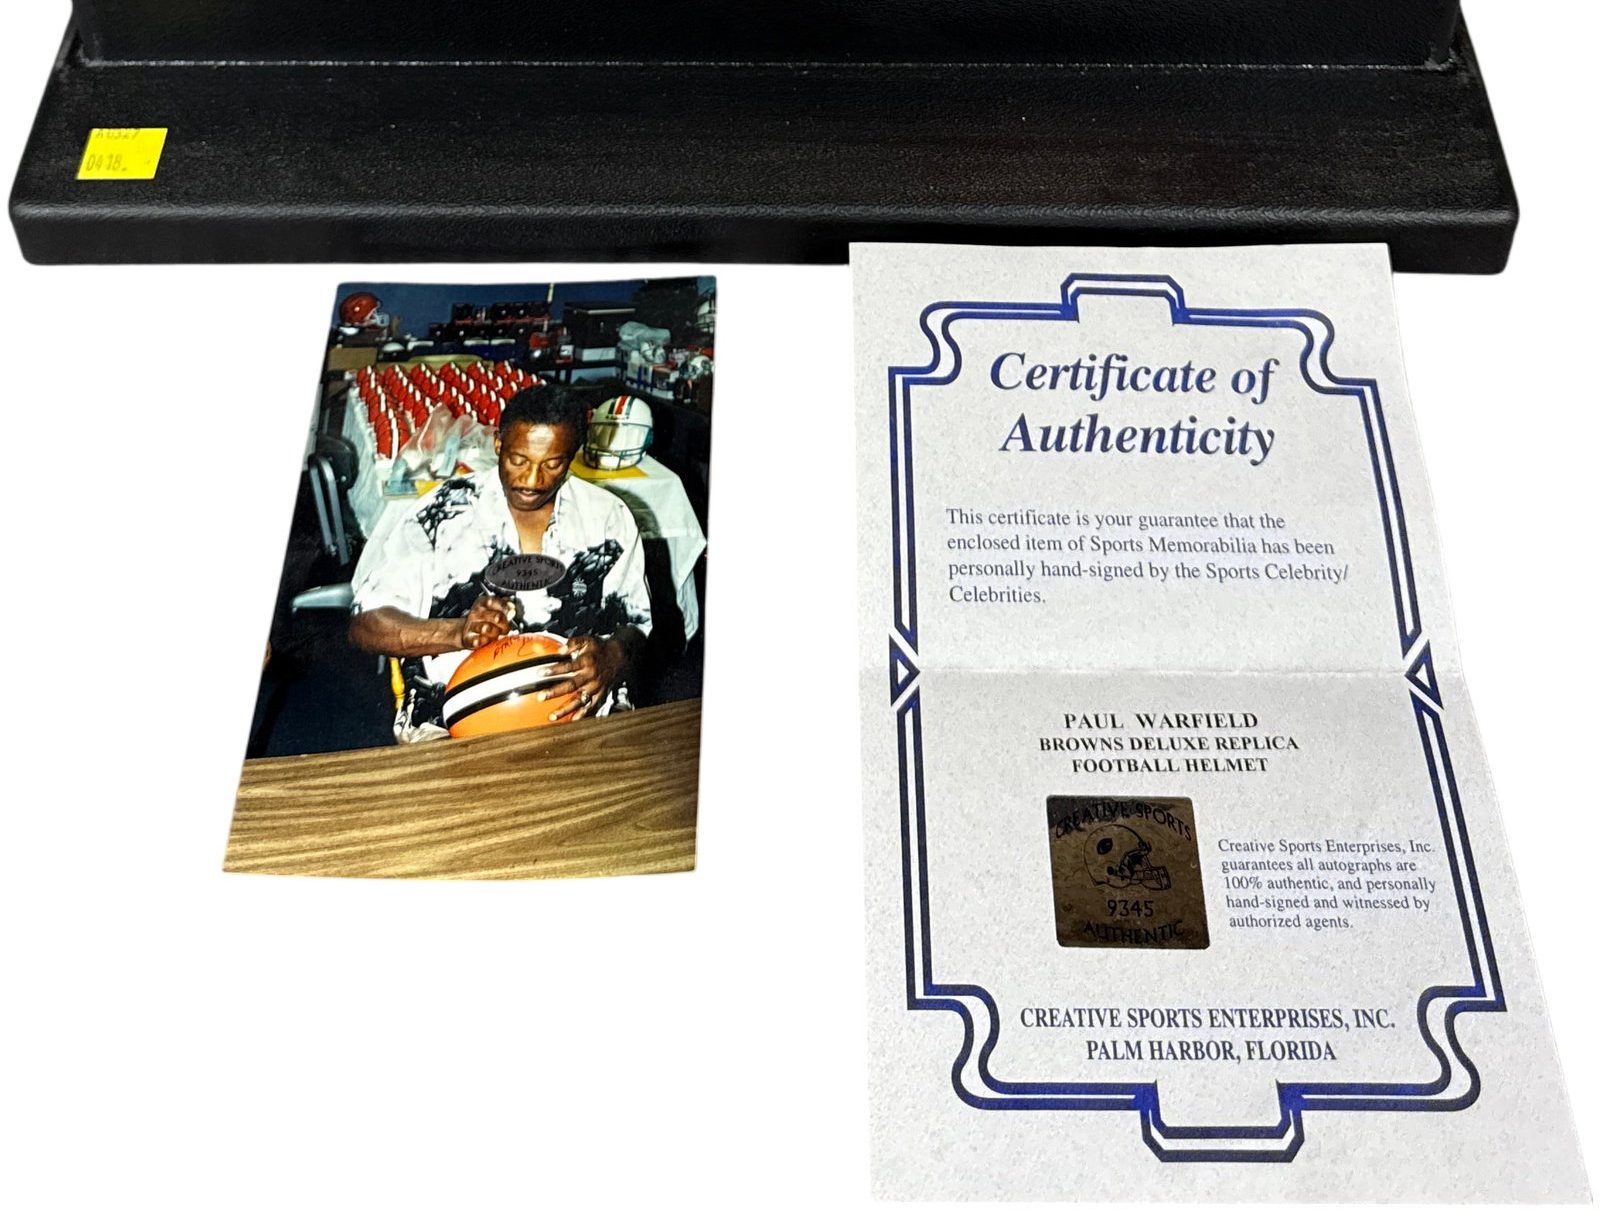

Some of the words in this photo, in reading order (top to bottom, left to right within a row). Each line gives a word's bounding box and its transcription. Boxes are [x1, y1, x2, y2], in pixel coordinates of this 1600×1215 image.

[989, 351, 1217, 403] Certificate
[1230, 357, 1281, 406] of
[997, 412, 1276, 468] Authenticity
[945, 507, 984, 527] This
[987, 508, 1072, 528] certificate
[1075, 509, 1090, 527] is
[1093, 514, 1134, 530] your
[1138, 513, 1219, 532] guarantee
[1223, 511, 1256, 529] that
[1258, 512, 1286, 530] the
[946, 533, 1021, 551] enclosed
[1025, 535, 1063, 552] item
[1067, 535, 1087, 552] of
[1089, 535, 1144, 557] Sports
[1147, 535, 1258, 554] Memorabilia
[1260, 537, 1290, 555] has
[1293, 537, 1336, 555] been
[516, 568, 539, 578] 9345
[948, 559, 1036, 582] personally
[1040, 559, 1145, 583] hand-signed
[1147, 561, 1170, 583] by
[1174, 561, 1202, 580] the
[1205, 562, 1261, 584] Sports
[1264, 562, 1349, 586] Celebrity/
[948, 584, 1046, 604] Celebrities.
[1063, 712, 1125, 730] PAUL
[1134, 712, 1259, 730] WARFIELD
[1038, 736, 1125, 752] BROWNS
[1127, 736, 1210, 752] DELUXE
[1213, 735, 1300, 751] REPLICA
[1071, 757, 1181, 774] FOOTBALL
[1183, 757, 1269, 773] HELMET
[1055, 800, 1130, 839] CREATIVE
[1135, 802, 1193, 842] SPORTS
[1217, 838, 1276, 853] Creative
[1278, 838, 1323, 856] Sports
[1324, 838, 1407, 857] Enterprises,
[1408, 839, 1436, 853] Inc.
[1221, 859, 1294, 875] guarantees
[1296, 857, 1315, 871] all
[1317, 857, 1393, 876] autographs
[1395, 861, 1418, 872] are
[1224, 875, 1263, 890] 100%
[1266, 875, 1334, 892] authentic,
[1336, 876, 1363, 891] and
[1365, 876, 1437, 894] personally
[1106, 898, 1155, 918] 9345
[1225, 894, 1311, 913] hand-signed
[1313, 894, 1339, 910] and
[1341, 894, 1411, 910] witnessed
[1412, 895, 1431, 913] by
[1083, 918, 1185, 944] AUTHENTIC
[1229, 913, 1302, 929] authorized
[1305, 915, 1354, 932] agents.
[1019, 1007, 1123, 1029] CREATIVE
[1126, 1007, 1203, 1029] SPORTS
[1206, 1007, 1350, 1033] ENTERPRISES,
[1353, 1008, 1396, 1030] INC.
[1085, 1039, 1145, 1061] PALM
[1147, 1039, 1242, 1066] HARBOR,
[1245, 1039, 1338, 1062] FLORIDA
